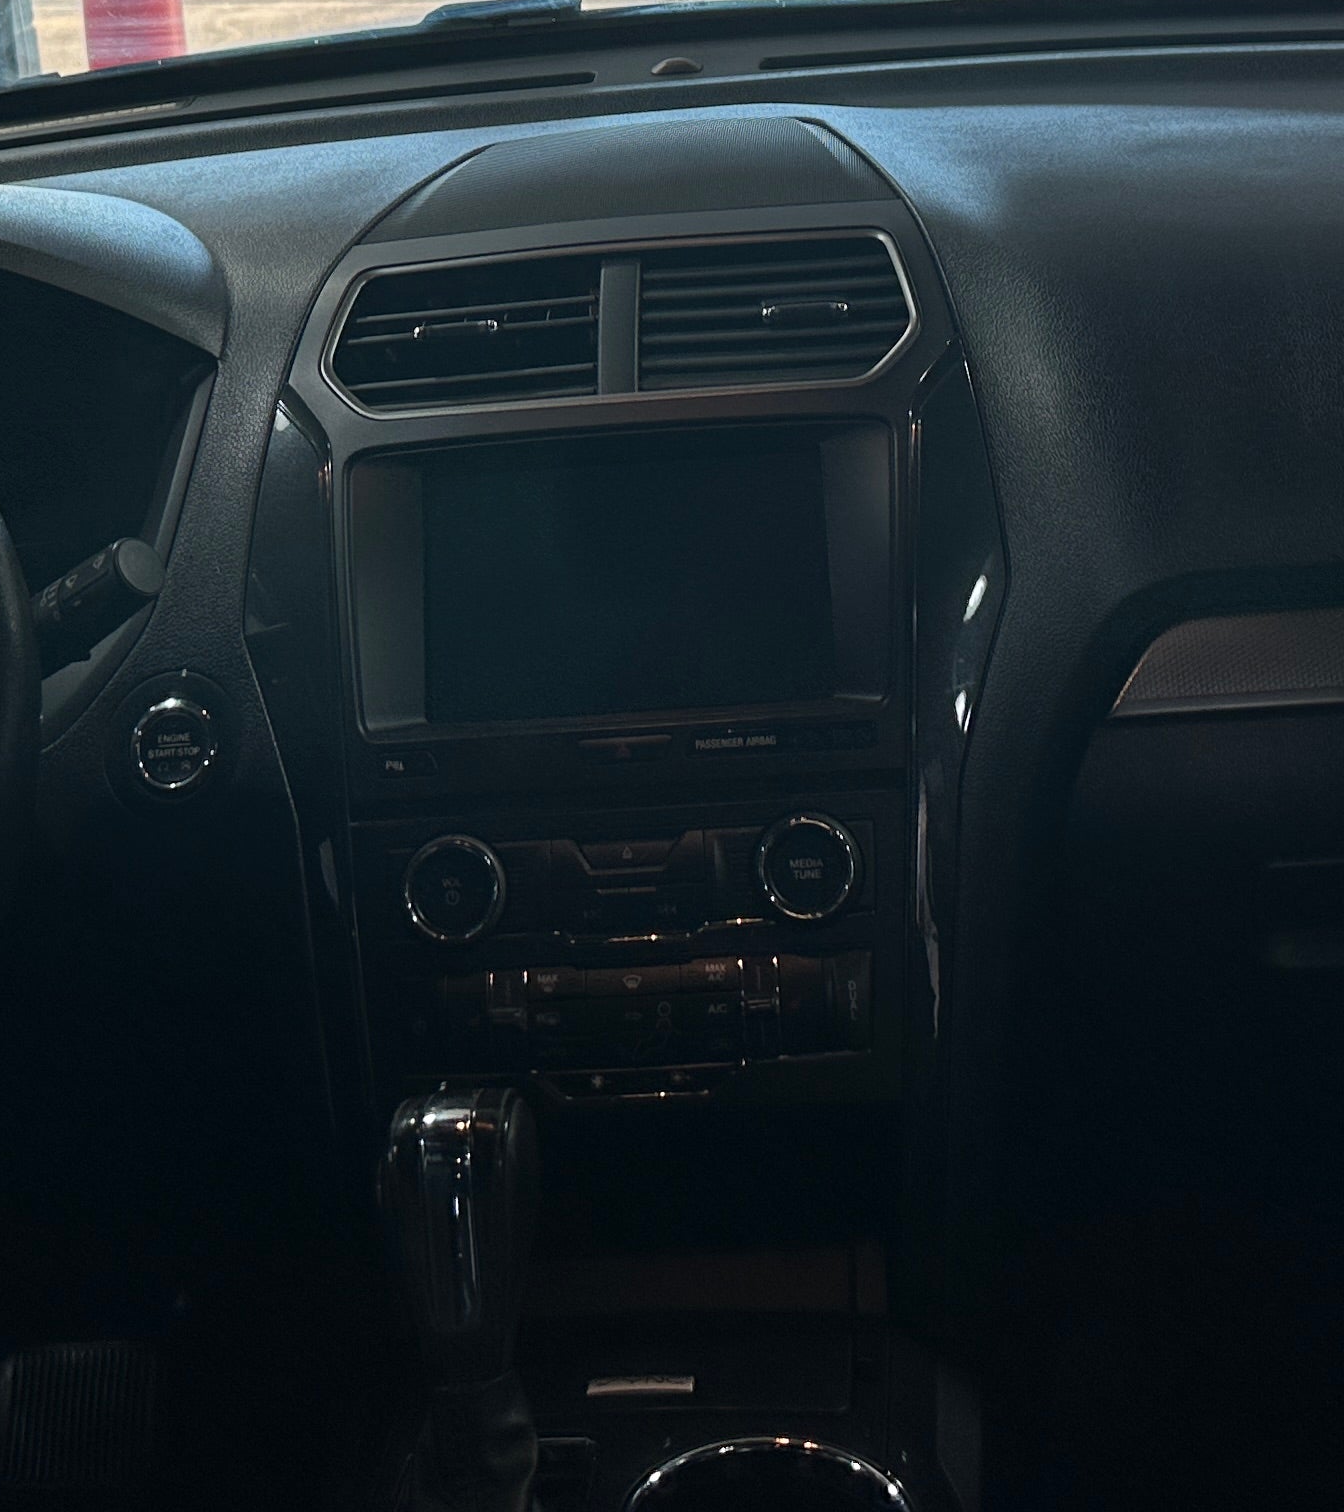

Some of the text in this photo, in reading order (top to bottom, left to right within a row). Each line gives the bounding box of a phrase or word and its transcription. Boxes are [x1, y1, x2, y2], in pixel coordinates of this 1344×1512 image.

[157, 733, 193, 745] ENGINE
[695, 735, 777, 751] PASSENGER AIRBAG
[147, 746, 201, 760] START STOP
[788, 857, 825, 869] MEDIA
[793, 868, 823, 880] TUNE
[707, 1002, 728, 1015] A/C
